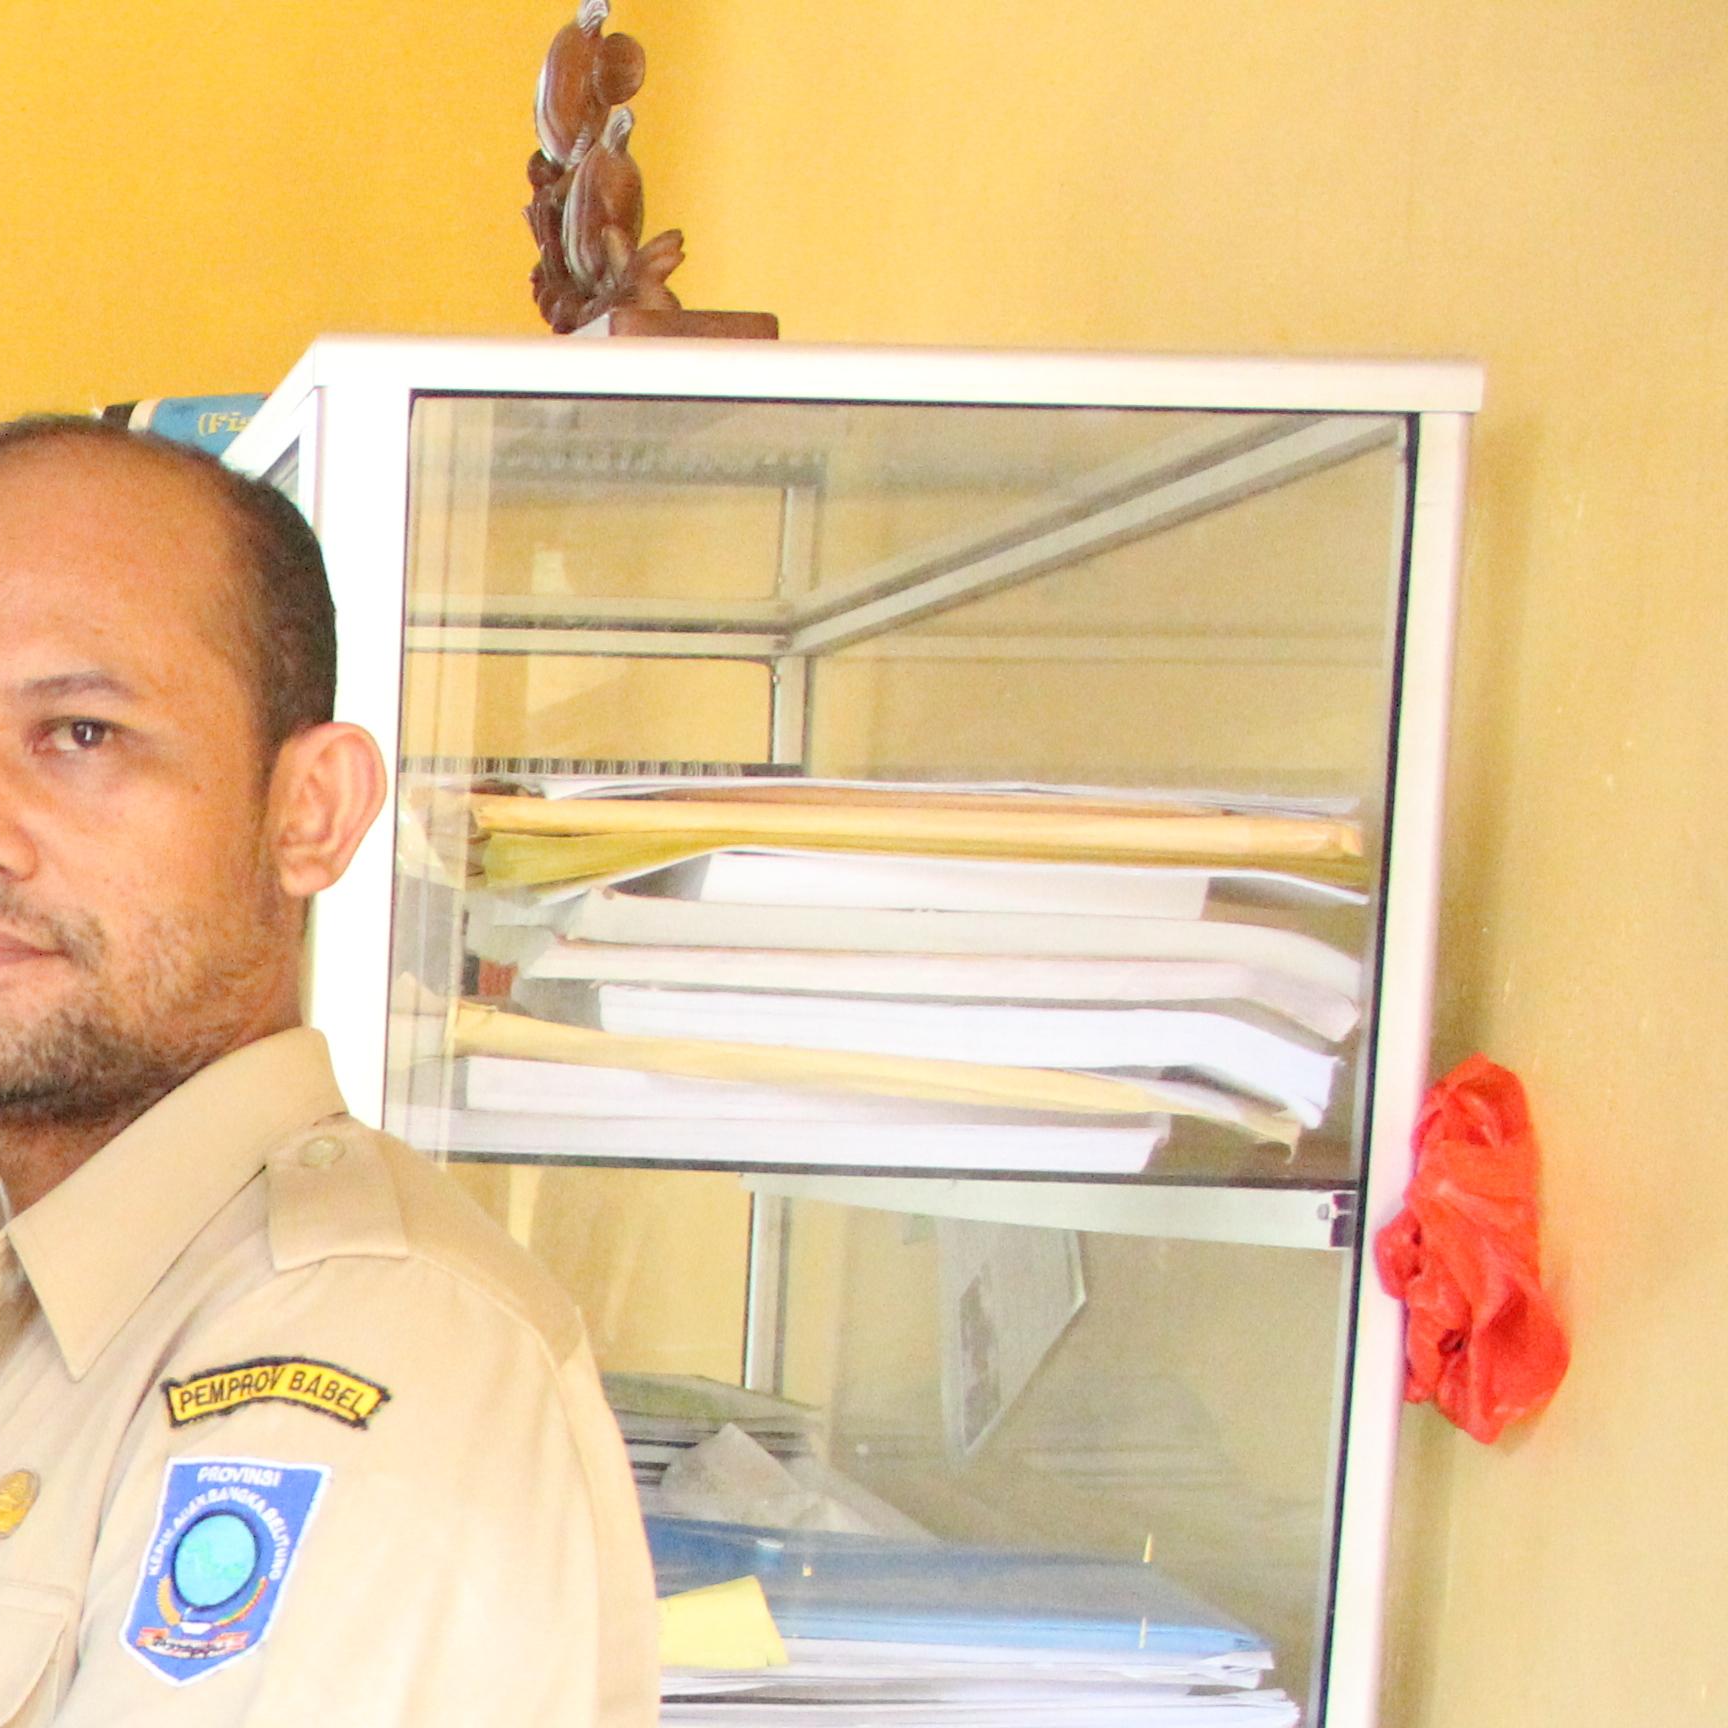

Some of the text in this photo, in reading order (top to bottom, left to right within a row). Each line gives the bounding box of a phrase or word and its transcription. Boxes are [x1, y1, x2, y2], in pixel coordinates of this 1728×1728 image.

[179, 1366, 365, 1413] PEMPROV BABEL
[196, 1465, 283, 1487] PROVINSI
